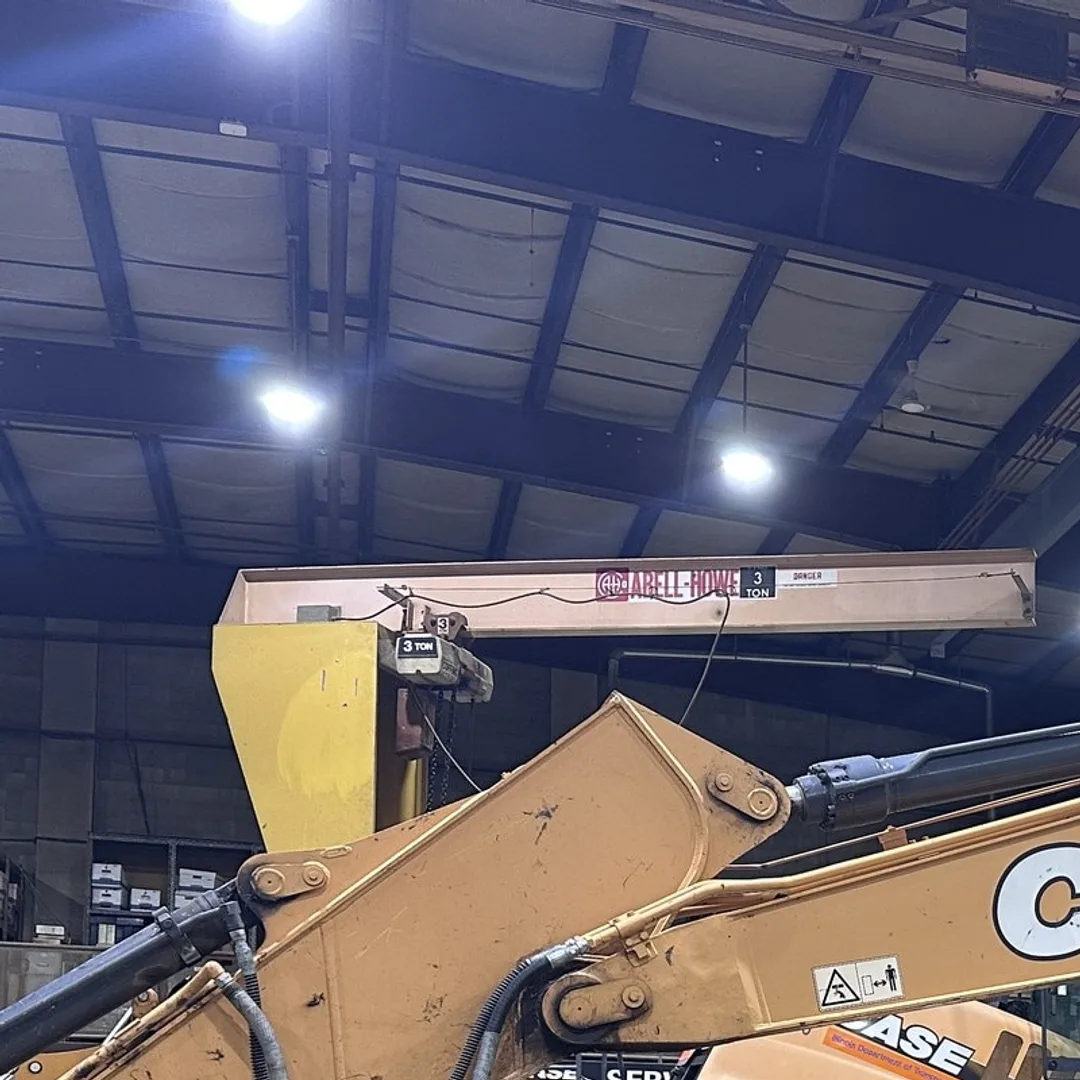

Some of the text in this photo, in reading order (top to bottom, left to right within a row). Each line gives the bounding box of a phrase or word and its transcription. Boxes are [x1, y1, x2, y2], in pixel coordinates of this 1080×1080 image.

[631, 569, 740, 599] ABELL-HOWE
[753, 571, 763, 585] 3
[746, 588, 770, 598] TON
[438, 618, 447, 629] 3
[403, 640, 433, 652] 3 TON
[857, 1045, 902, 1069] Department
[903, 1063, 913, 1072] of
